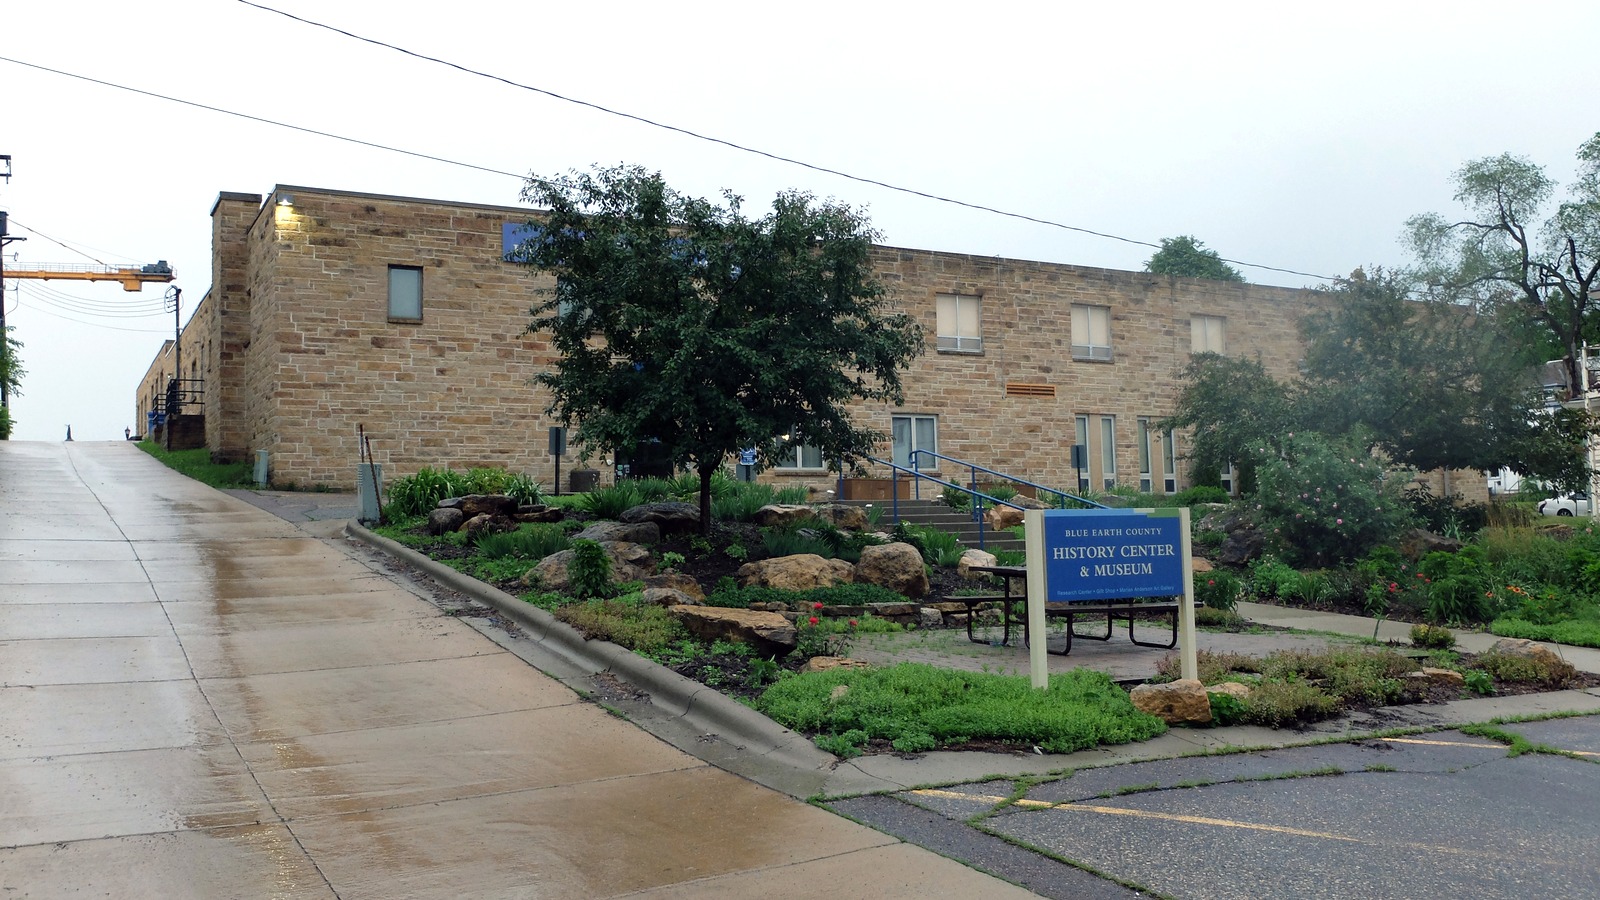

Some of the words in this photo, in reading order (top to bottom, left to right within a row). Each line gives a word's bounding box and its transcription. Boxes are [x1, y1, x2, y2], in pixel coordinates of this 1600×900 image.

[1065, 529, 1088, 537] BLUE
[1092, 528, 1122, 537] EARTH
[1125, 527, 1162, 536] COUNTY
[1053, 546, 1116, 560] HISTORY
[1120, 544, 1175, 558] CENTER
[1080, 565, 1090, 577] &
[1094, 563, 1153, 577] MUSEUM
